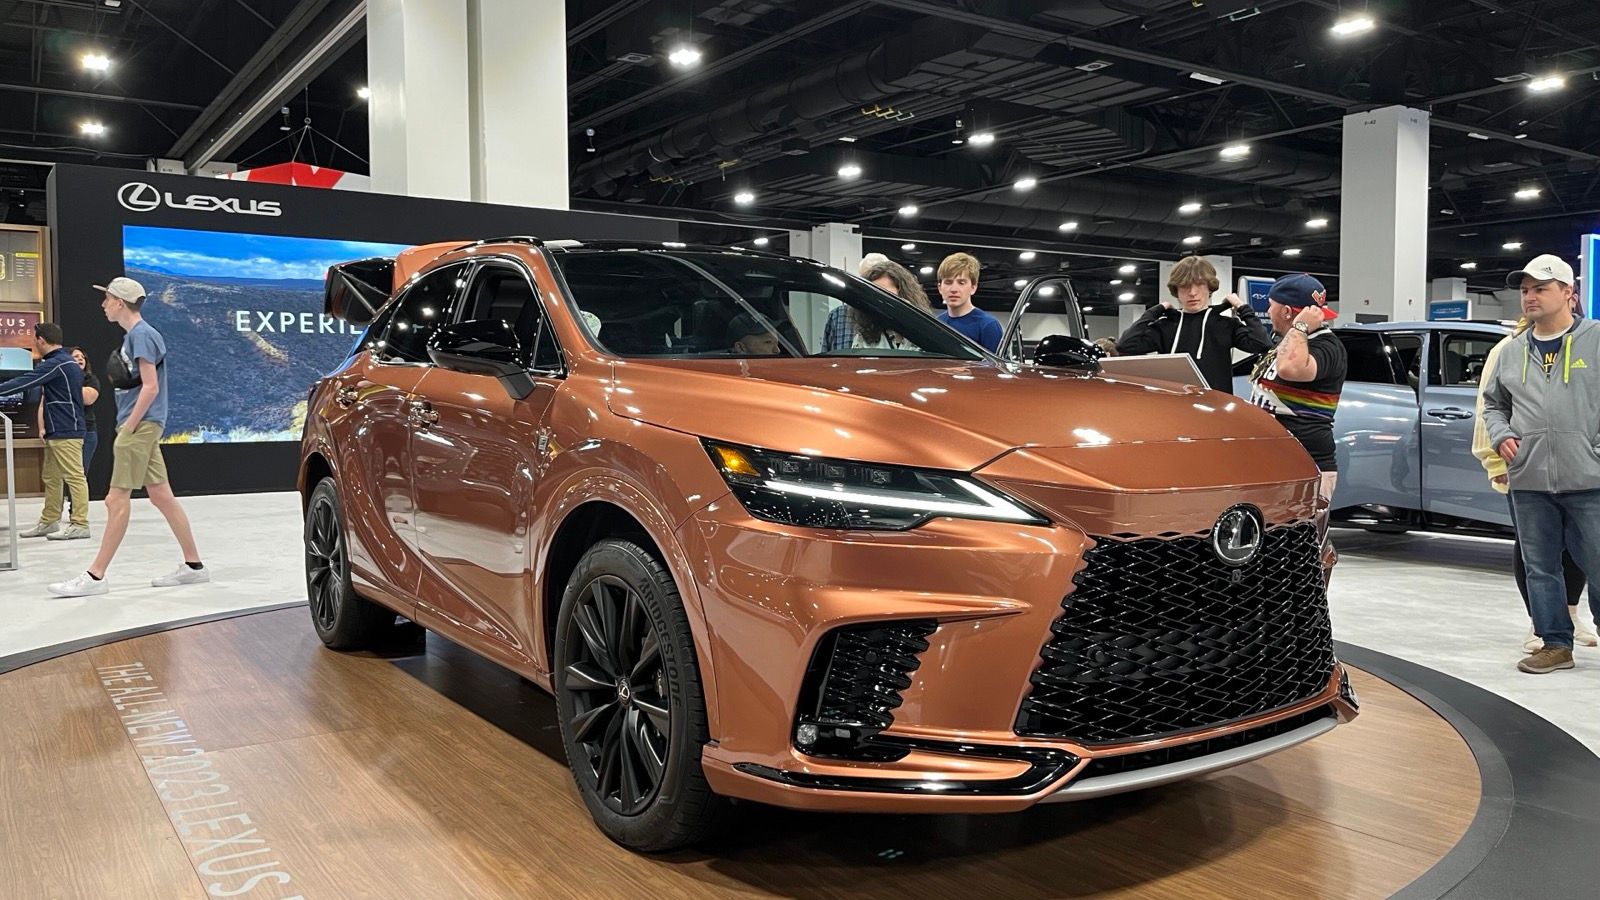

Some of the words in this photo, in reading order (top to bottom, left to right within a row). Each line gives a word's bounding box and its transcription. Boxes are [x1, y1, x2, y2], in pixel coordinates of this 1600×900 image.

[164, 192, 282, 217] LEXUS
[638, 577, 682, 707] BRIDGESTONE
[96, 661, 154, 686] THE
[107, 686, 197, 748] ALL-NEW
[142, 748, 230, 801] 2023
[171, 801, 290, 897] LEXUS
